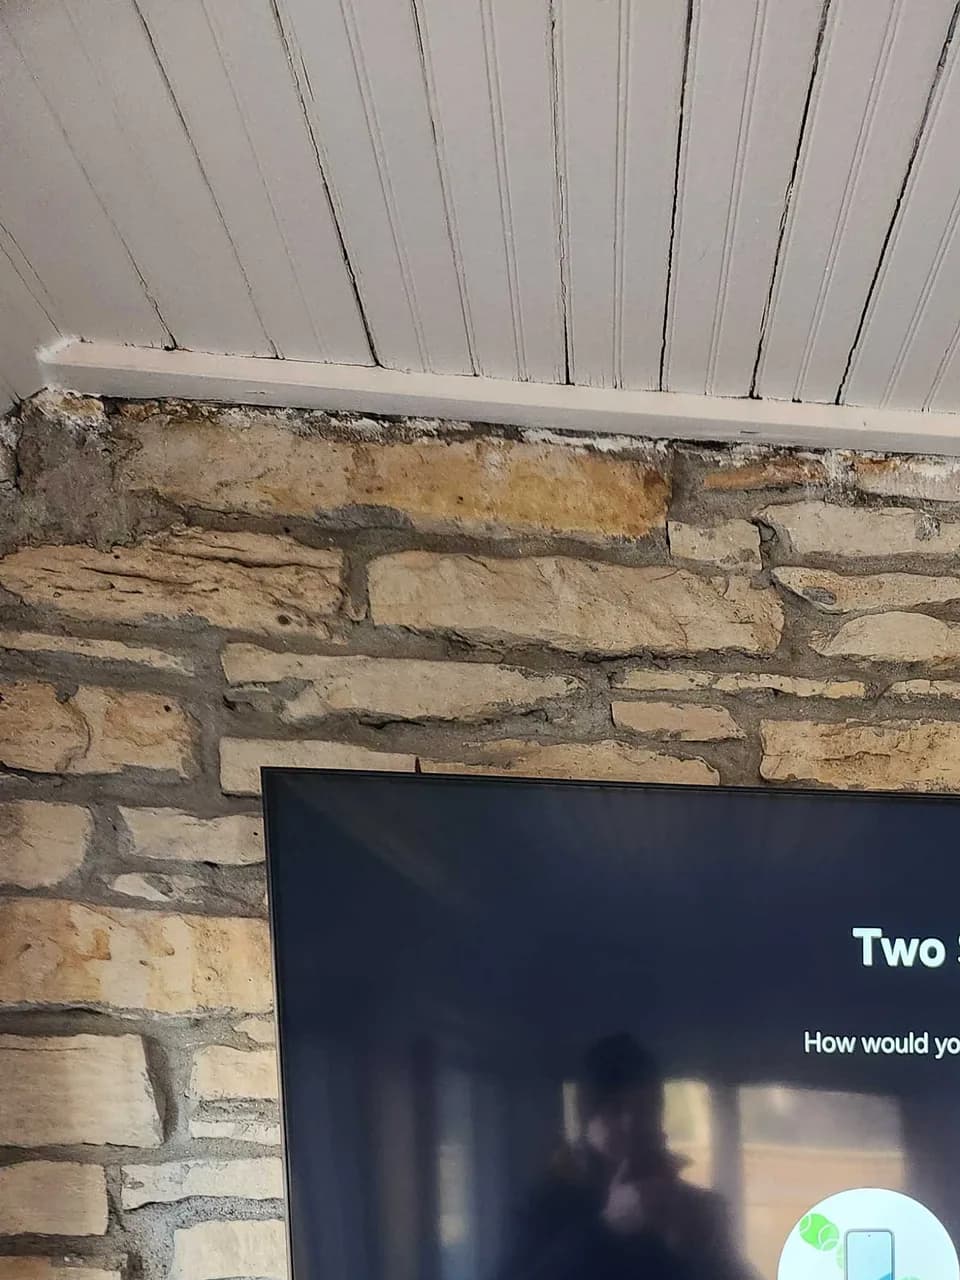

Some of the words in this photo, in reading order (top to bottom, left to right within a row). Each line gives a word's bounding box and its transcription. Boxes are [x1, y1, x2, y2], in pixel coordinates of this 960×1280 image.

[852, 927, 946, 968] Two
[804, 1031, 857, 1054] How
[861, 1031, 929, 1054] would
